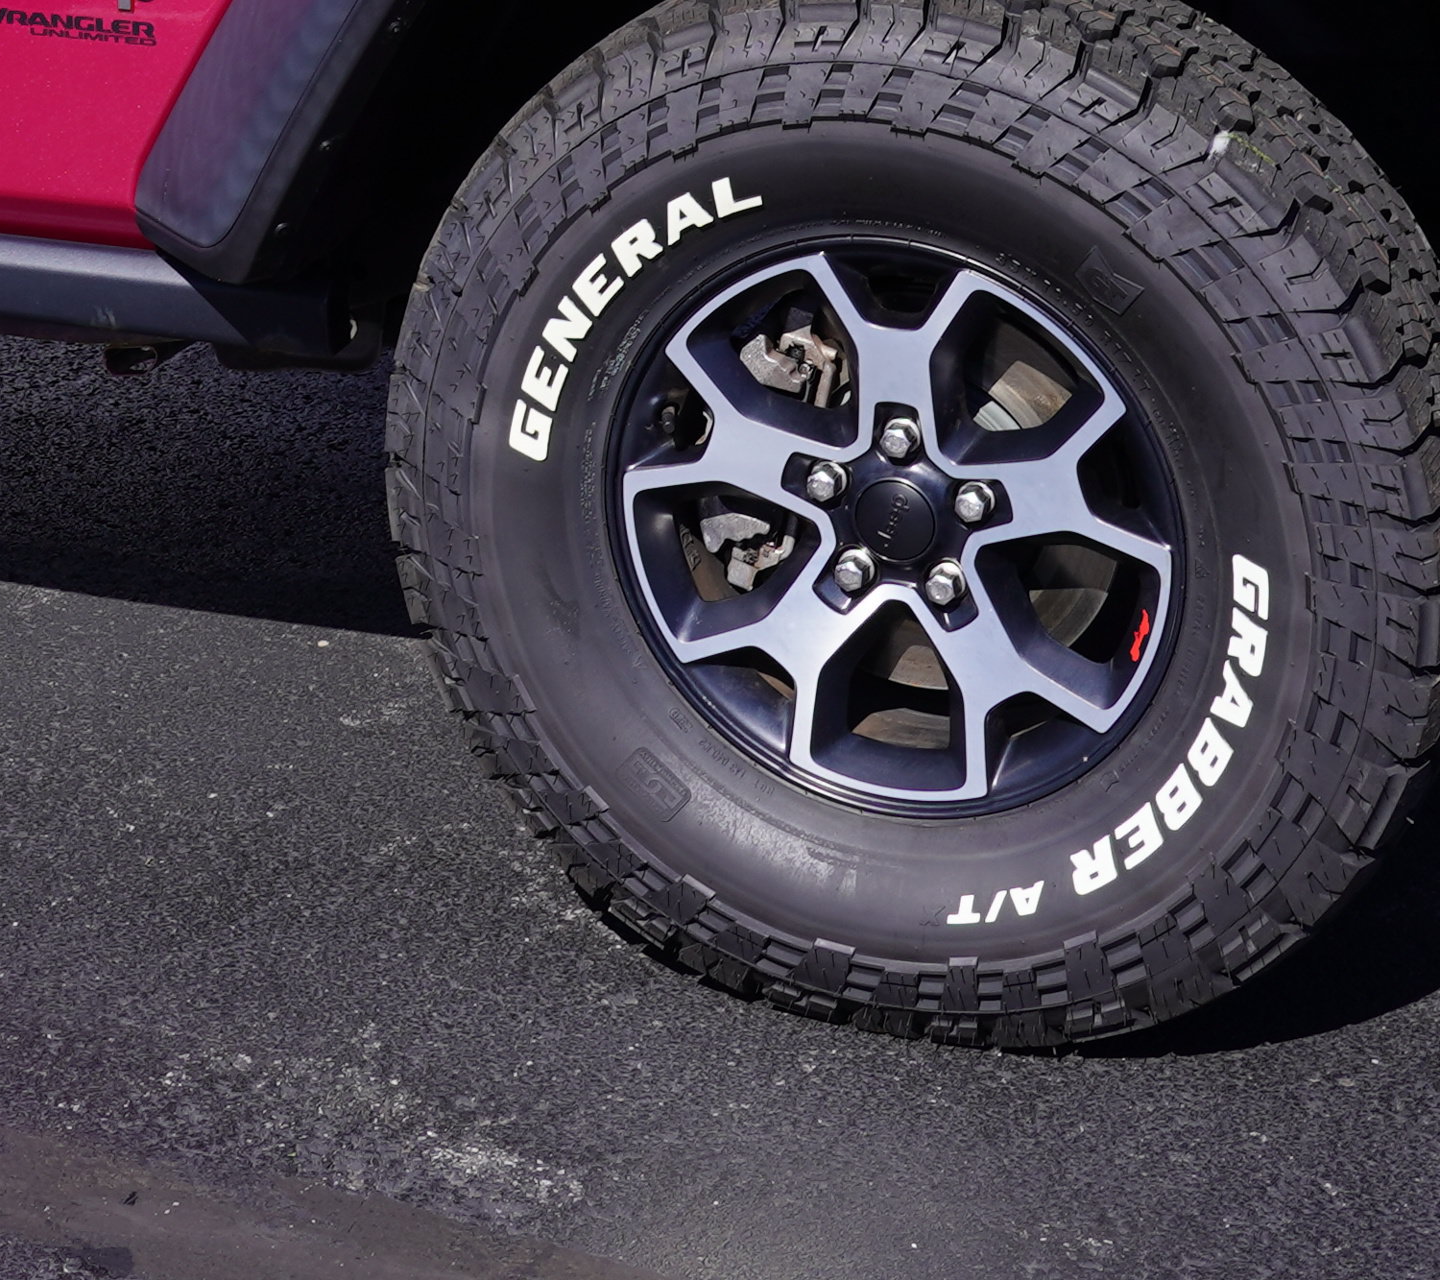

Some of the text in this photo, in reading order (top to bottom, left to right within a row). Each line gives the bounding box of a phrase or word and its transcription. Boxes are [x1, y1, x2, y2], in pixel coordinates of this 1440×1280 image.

[29, 26, 157, 47] UNLIMITED
[508, 177, 764, 463] GENERAL
[1069, 553, 1270, 896] GRABBER
